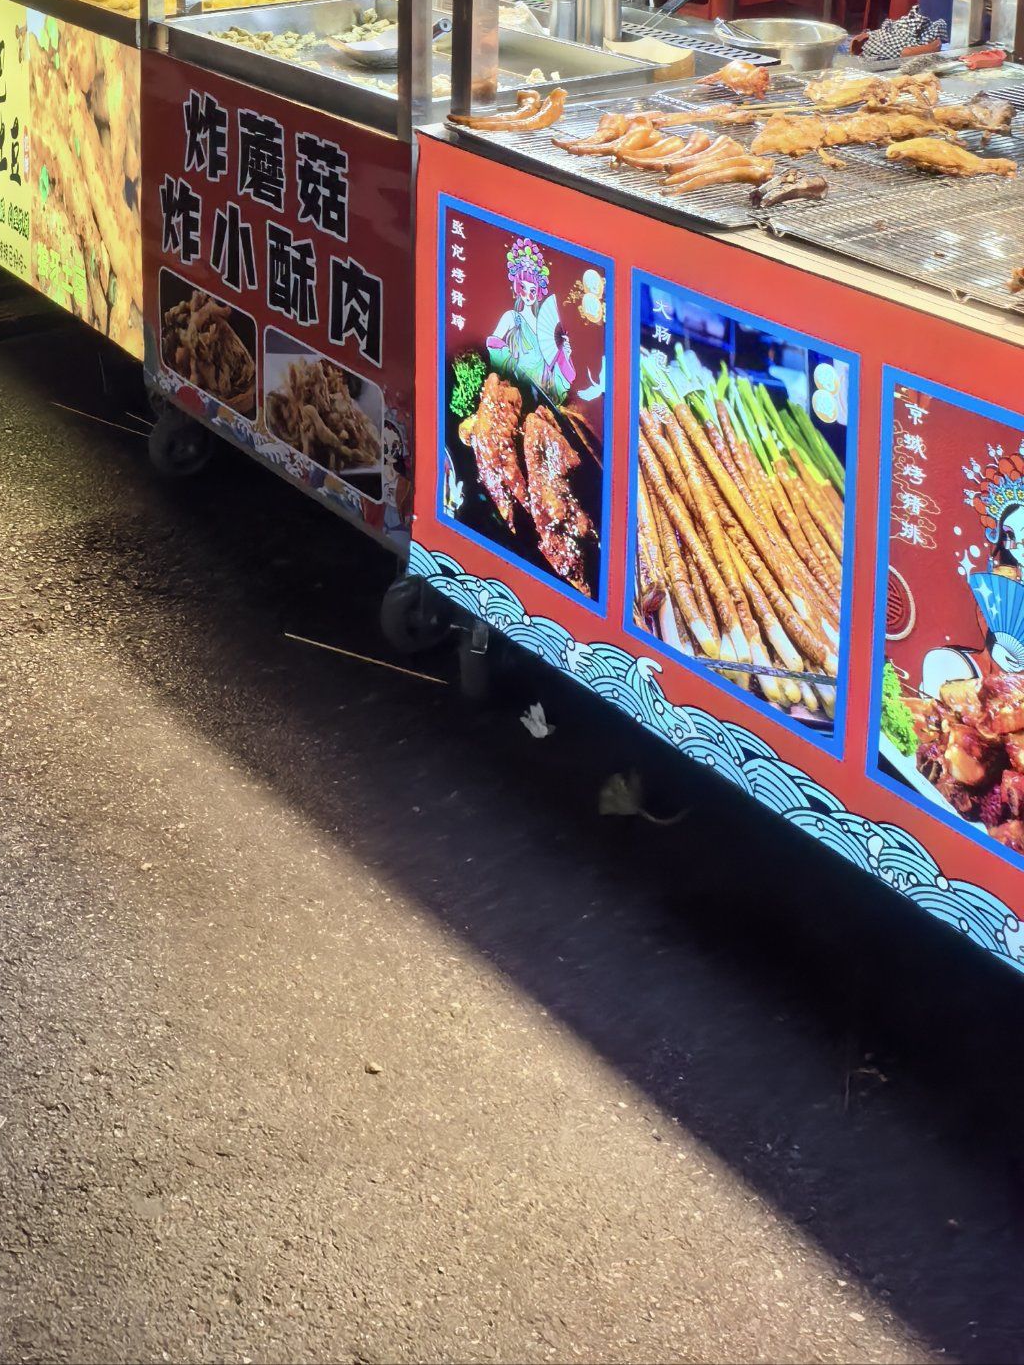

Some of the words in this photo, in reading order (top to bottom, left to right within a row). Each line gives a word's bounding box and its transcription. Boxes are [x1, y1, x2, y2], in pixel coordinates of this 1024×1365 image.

[183, 88, 349, 243] 炸蘑菇
[158, 174, 384, 369] 炸小酥肉
